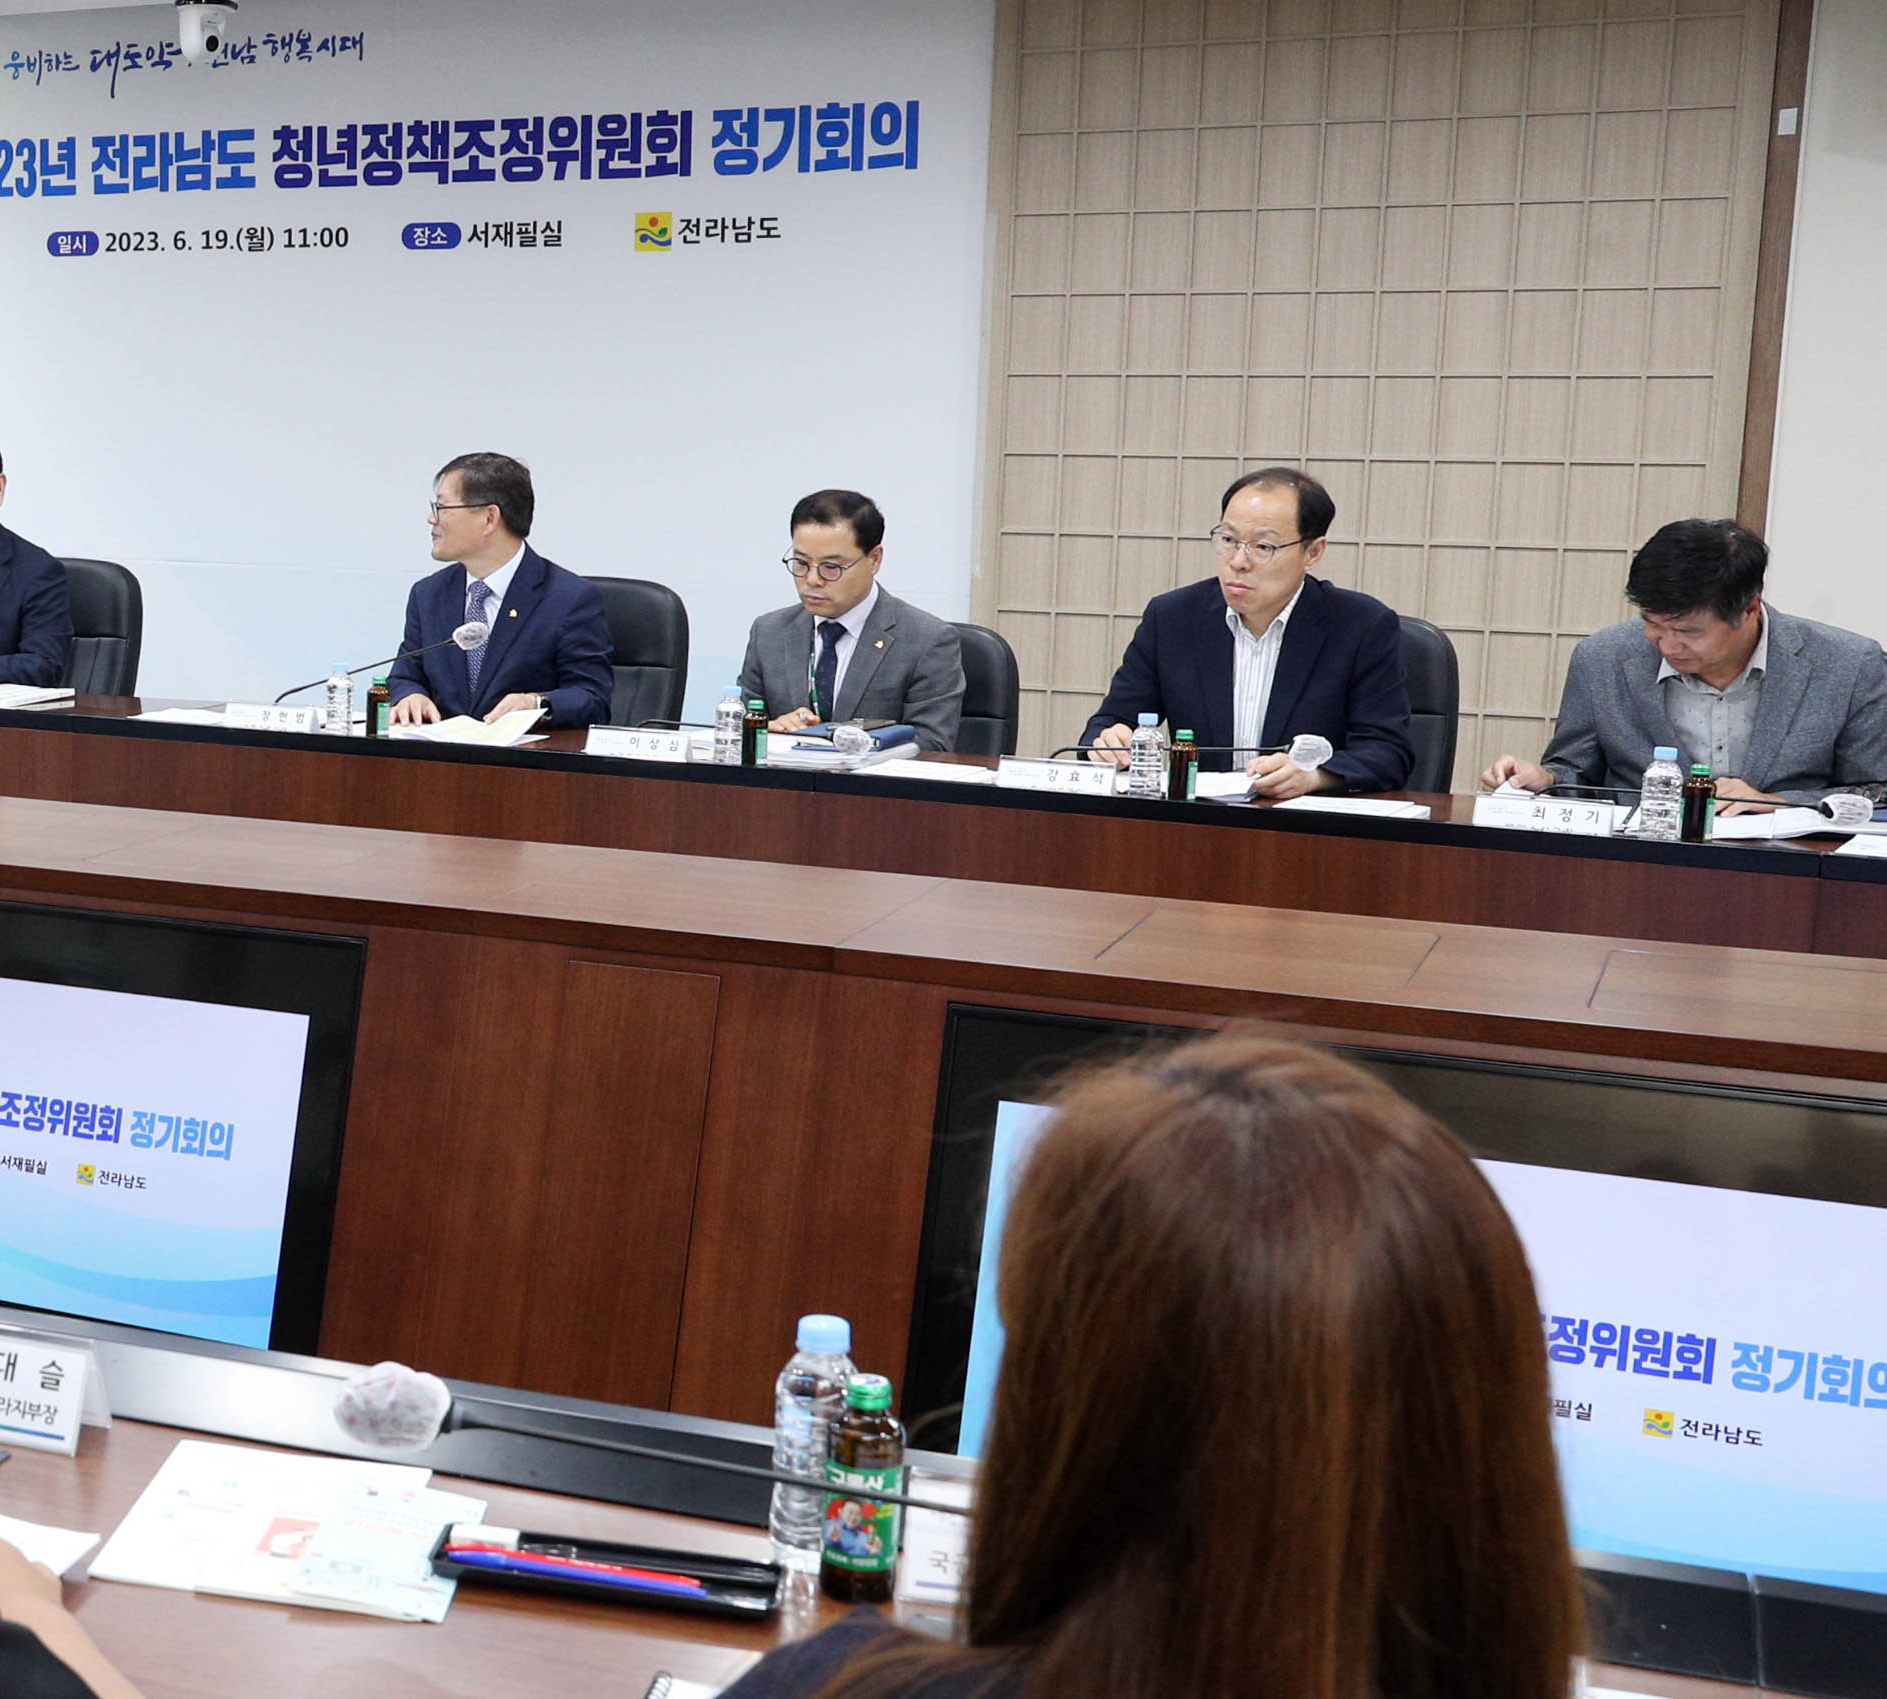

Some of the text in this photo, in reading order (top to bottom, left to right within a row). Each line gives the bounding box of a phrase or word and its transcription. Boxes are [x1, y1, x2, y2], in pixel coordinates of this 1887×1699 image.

[4, 49, 80, 85] 웅비하는
[89, 41, 192, 98] 대도약
[91, 128, 256, 195] 전라남도
[272, 109, 693, 189] 청년정책조정위원회
[711, 100, 920, 176] 정기회의
[56, 220, 563, 255] 일시 2023. 6. 19.(월) 11:00 장소 서재필실
[677, 216, 782, 244] 전라남도
[1531, 804, 1601, 825] 최정기
[129, 1109, 235, 1160] 정기회의
[0, 1154, 47, 1175] 서재필실
[97, 1169, 147, 1190] 전라남도
[1541, 1313, 1717, 1385] 정위원회
[1553, 1397, 1593, 1422] 필실
[1679, 1417, 1764, 1447] 전라남도
